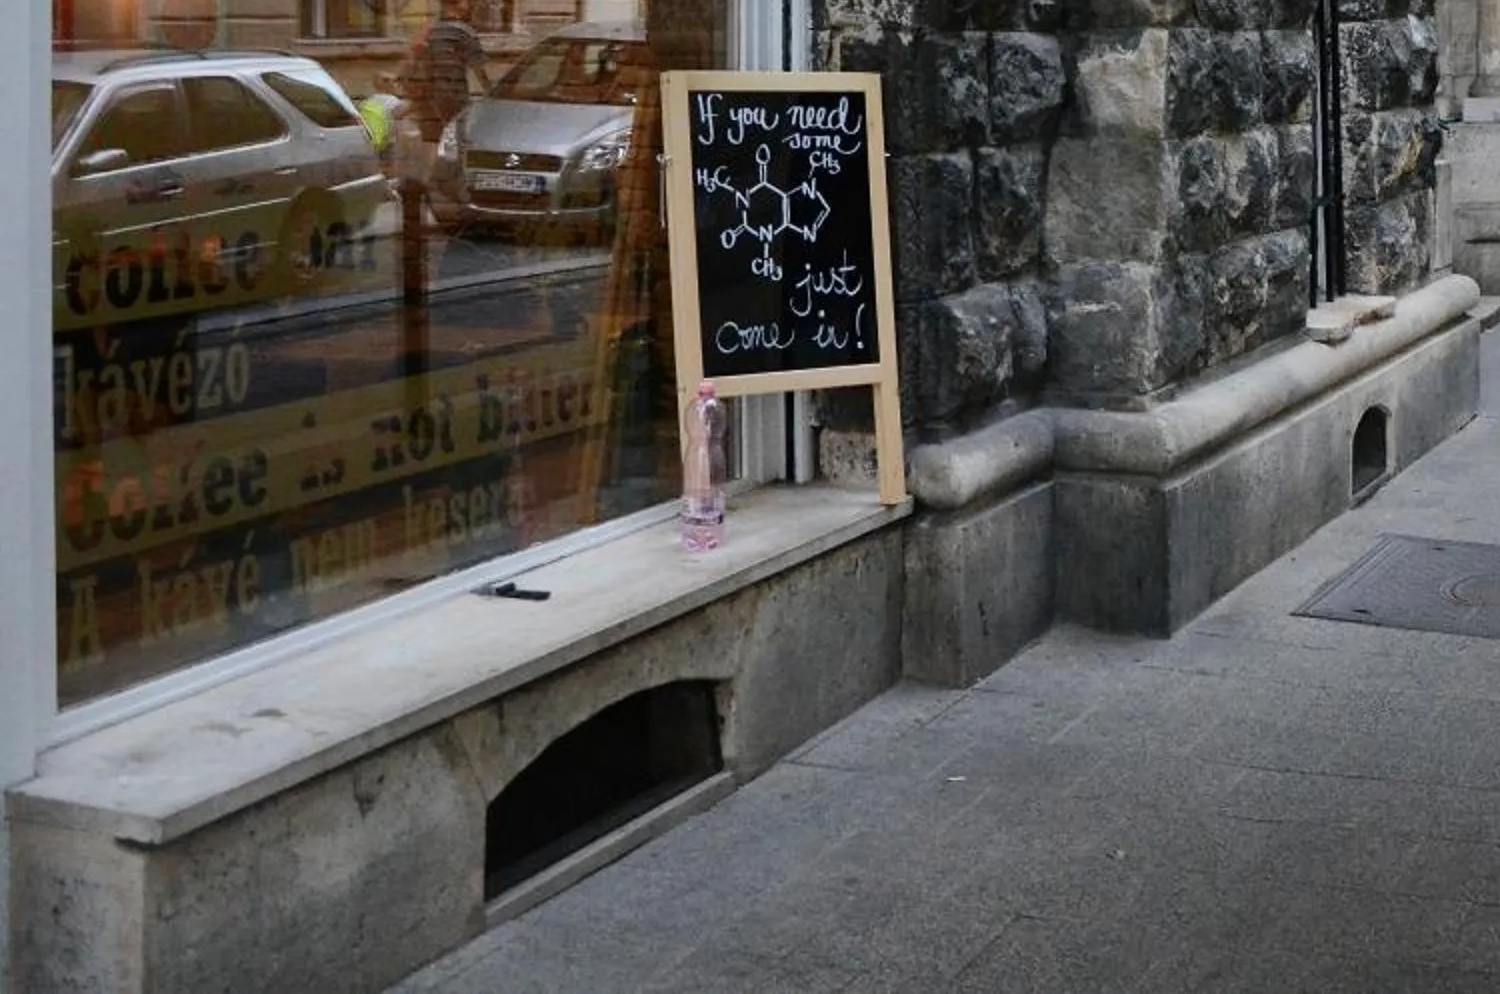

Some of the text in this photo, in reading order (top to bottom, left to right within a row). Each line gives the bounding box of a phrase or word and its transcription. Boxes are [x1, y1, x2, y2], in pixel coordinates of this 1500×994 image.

[697, 93, 862, 145] If you need
[782, 133, 861, 155] some
[789, 248, 863, 317] just
[56, 319, 250, 440] kávézó
[65, 442, 267, 552] Coffee
[371, 393, 455, 471] not
[136, 528, 260, 649] kávé
